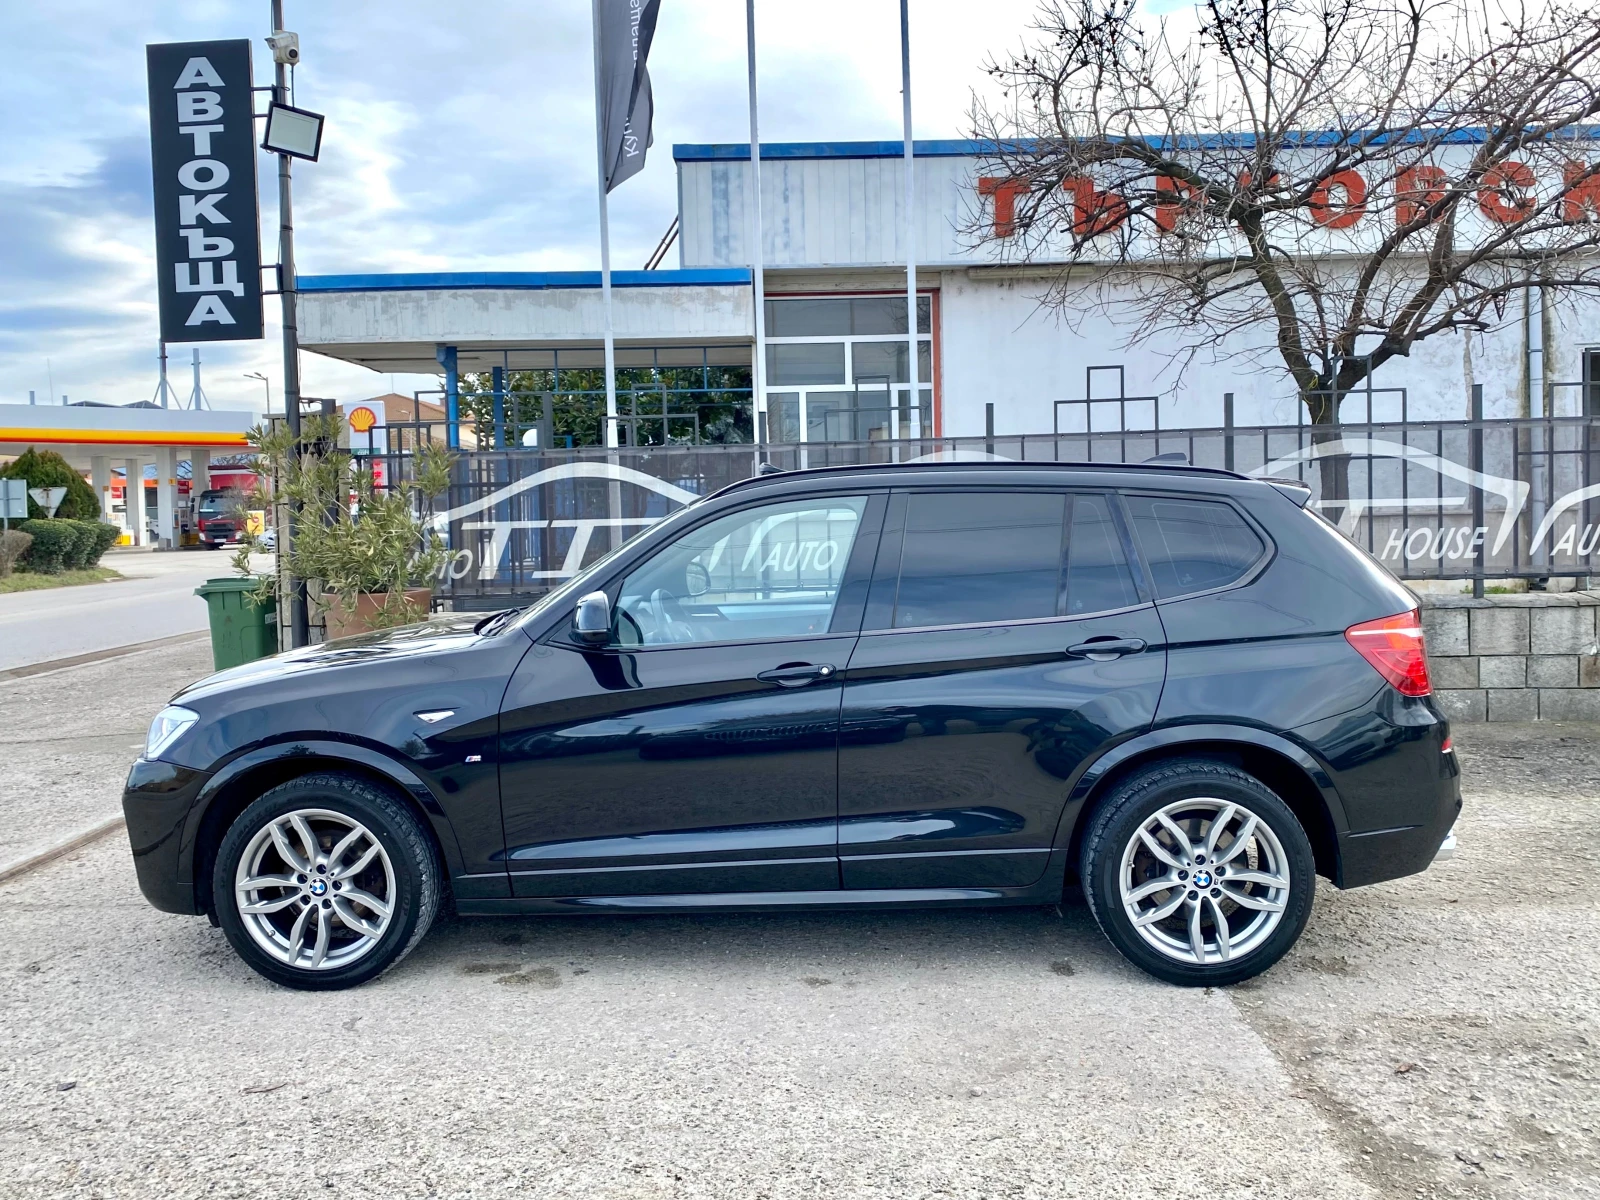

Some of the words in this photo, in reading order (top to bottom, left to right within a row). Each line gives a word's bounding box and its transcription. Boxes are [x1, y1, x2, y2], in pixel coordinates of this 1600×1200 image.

[173, 56, 244, 326] АВТОКЪЩА
[760, 540, 838, 572] AUTO
[1381, 526, 1489, 560] HOUSE
[1550, 524, 1600, 556] AU
[404, 549, 474, 580] ATO
